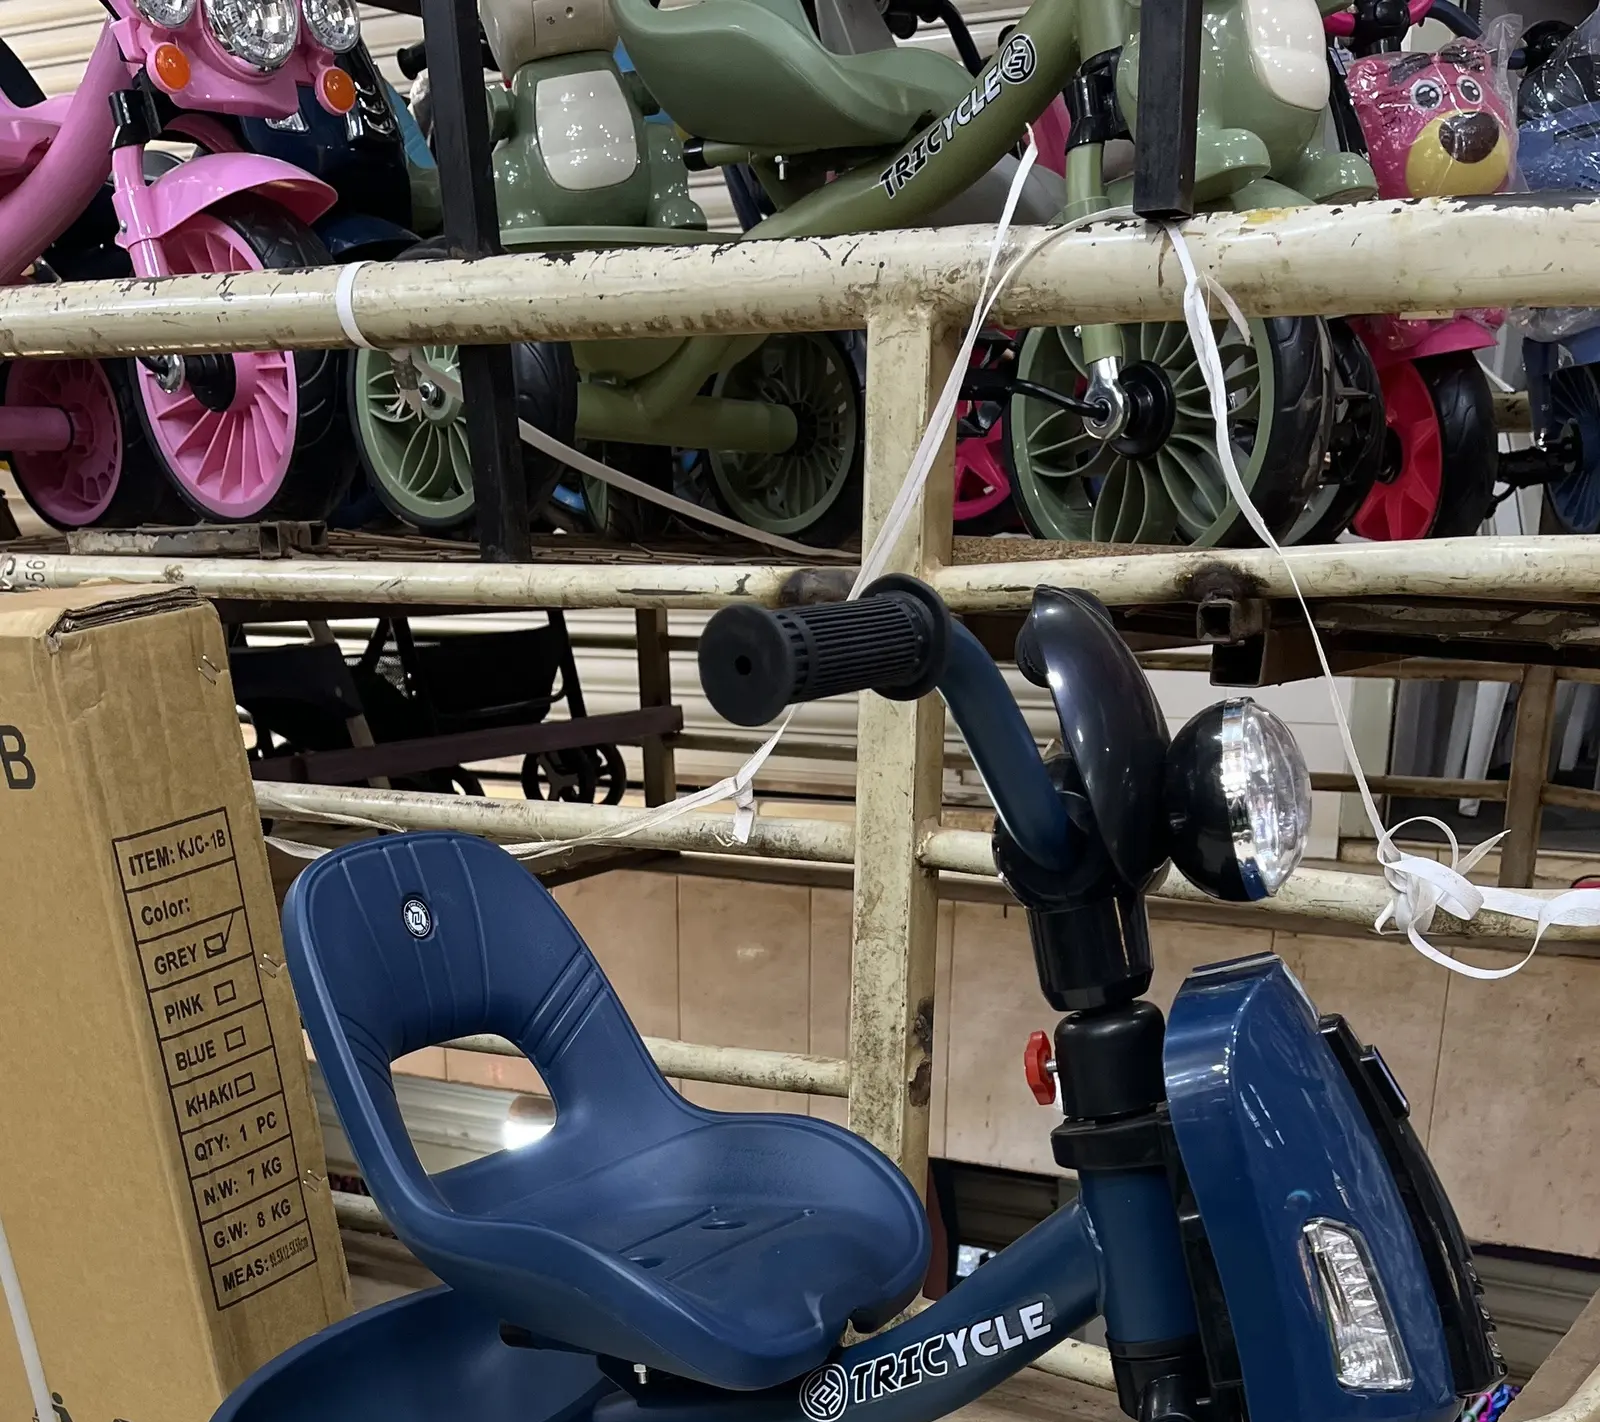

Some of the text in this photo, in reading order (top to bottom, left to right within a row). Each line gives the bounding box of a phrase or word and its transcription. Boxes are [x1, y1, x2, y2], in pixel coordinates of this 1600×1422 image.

[879, 63, 1003, 199] TRICYCLE
[128, 828, 226, 877] ITEM: KJC-1B
[140, 897, 191, 926] Color:
[153, 943, 197, 975] GREY
[164, 993, 204, 1025] PINK
[174, 1039, 217, 1072] BLUE
[185, 1081, 234, 1118] KHAKI
[194, 1111, 277, 1161] QTY: 1 PC
[203, 1156, 282, 1206] N.W: 7 KG
[213, 1198, 291, 1249] G.W: 8 KG
[222, 1258, 269, 1293] MEAS:
[850, 1301, 1052, 1404] TRICYCLE
